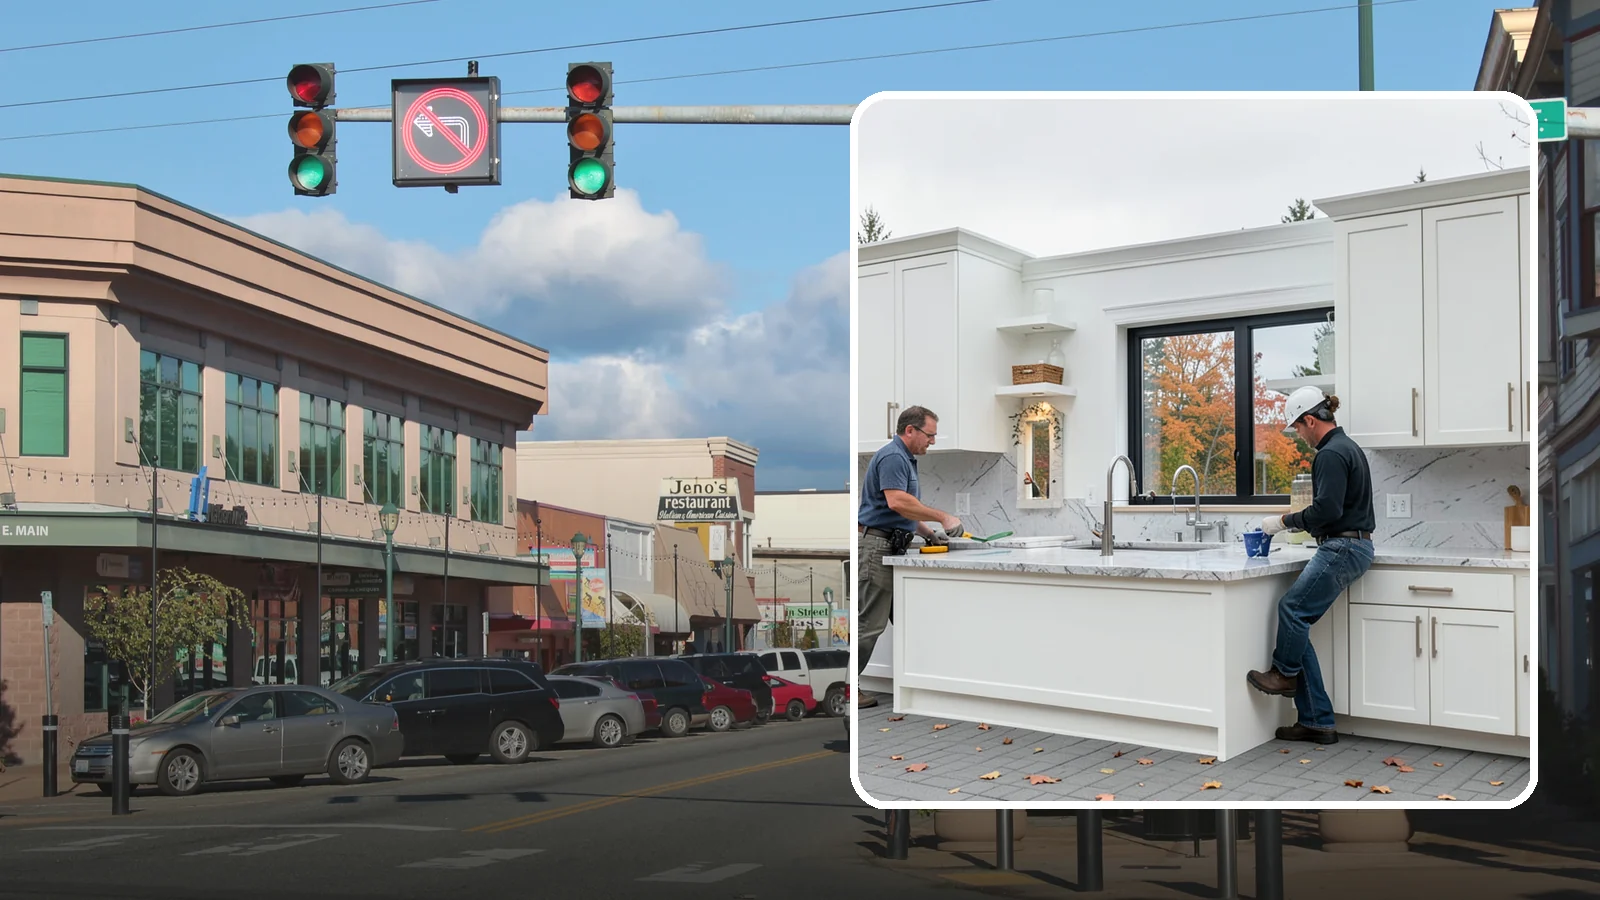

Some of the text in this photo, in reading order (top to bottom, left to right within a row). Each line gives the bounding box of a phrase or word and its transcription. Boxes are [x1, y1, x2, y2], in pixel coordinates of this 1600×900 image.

[669, 480, 727, 494] Jeno's
[665, 496, 731, 509] restaurant
[658, 509, 681, 519] Italian
[686, 509, 714, 519] American
[715, 509, 738, 519] Cuisine
[2, 525, 49, 536] E. MAIN
[797, 607, 828, 617] Street
[791, 619, 824, 627] lass
